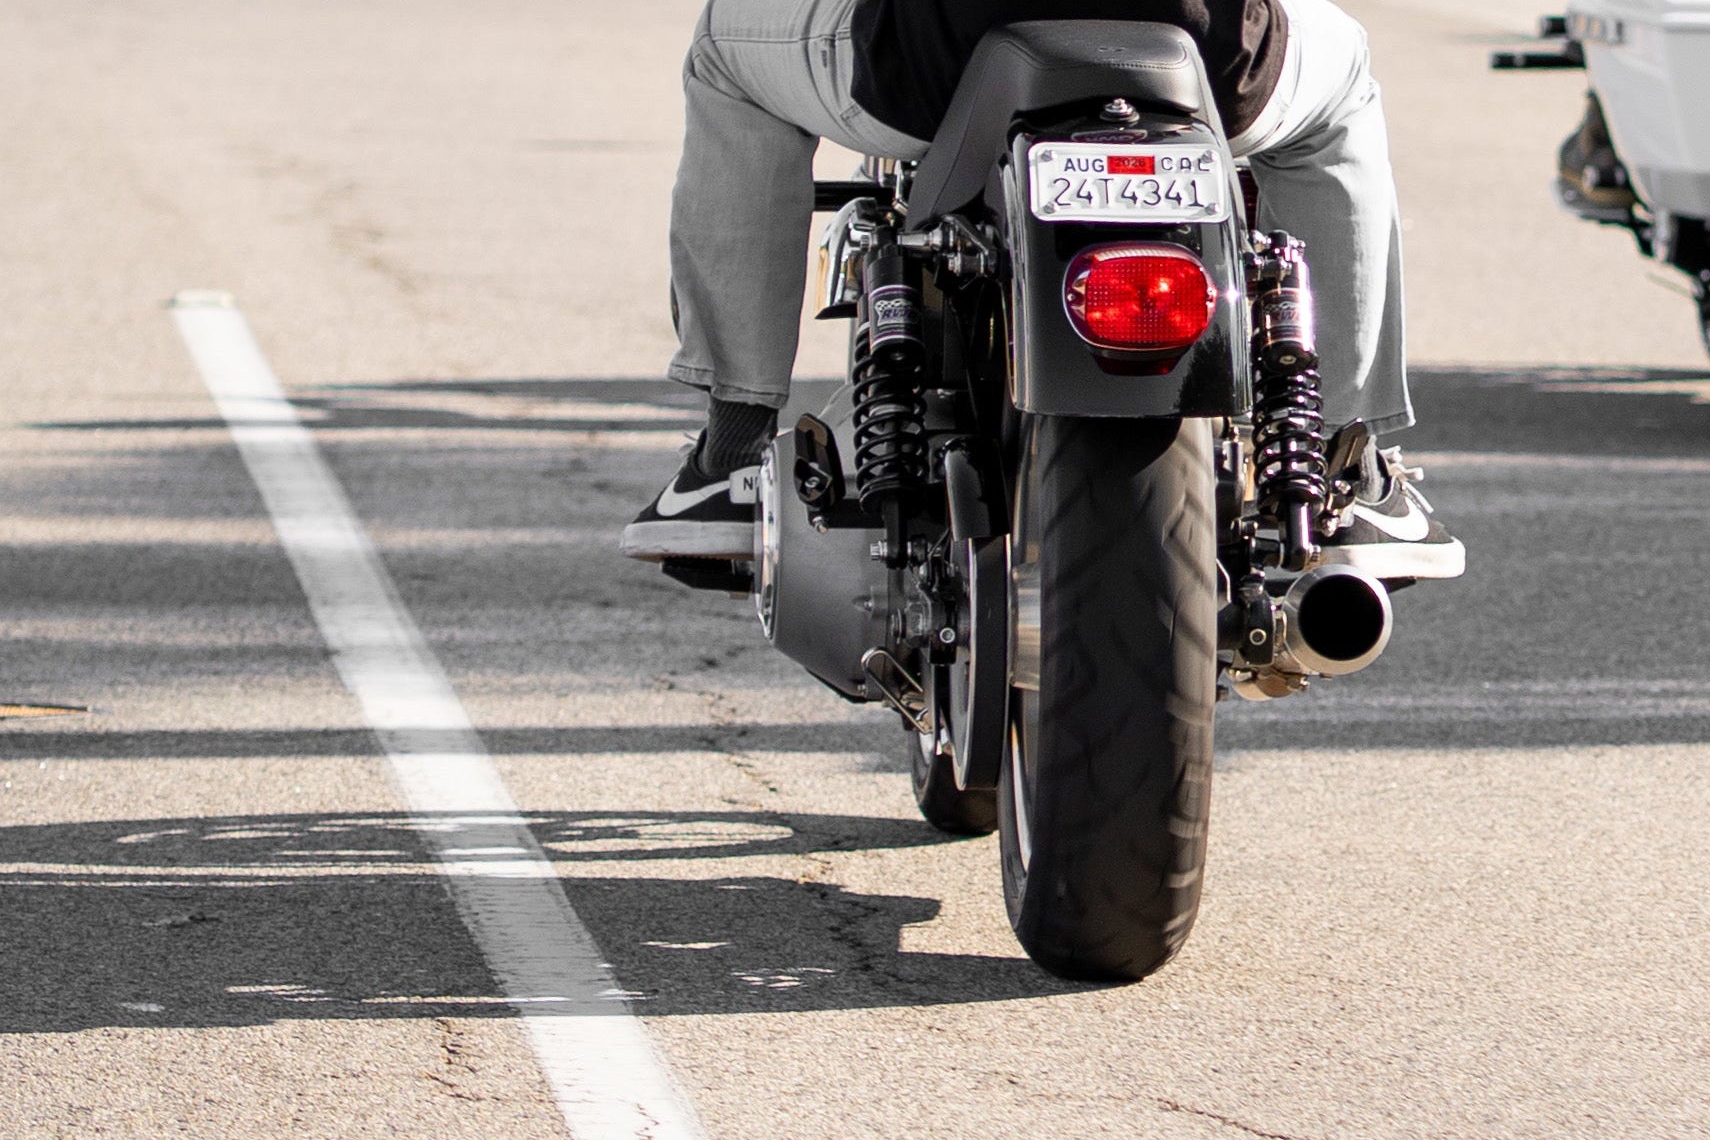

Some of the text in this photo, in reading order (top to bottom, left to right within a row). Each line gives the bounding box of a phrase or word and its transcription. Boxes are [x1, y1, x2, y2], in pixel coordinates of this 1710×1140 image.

[1064, 158, 1105, 173] AUG
[1161, 157, 1210, 173] CAL
[1053, 178, 1204, 207] 24T4341
